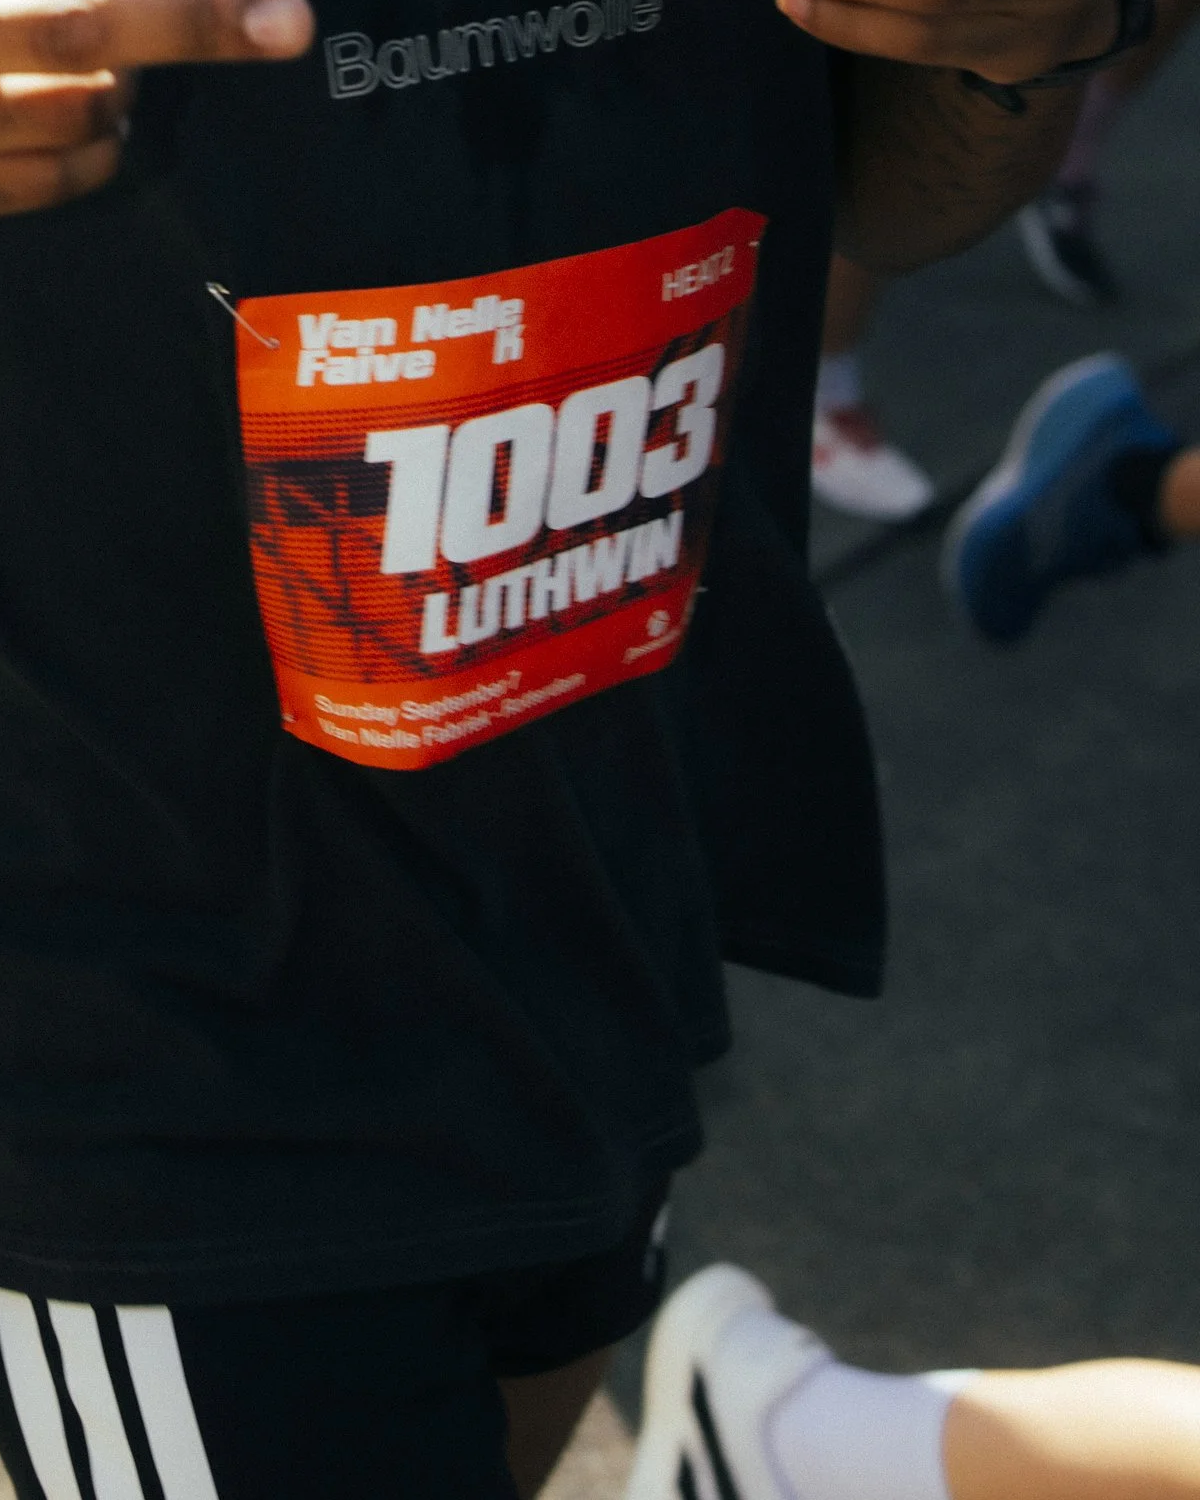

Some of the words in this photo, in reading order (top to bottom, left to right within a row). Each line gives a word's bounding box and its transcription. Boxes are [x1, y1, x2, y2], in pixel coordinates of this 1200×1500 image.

[297, 313, 397, 350] Van
[410, 295, 525, 343] Nelle
[296, 347, 437, 387] Faive
[363, 342, 725, 575] 1003
[419, 510, 684, 654] LUTHWIN
[314, 694, 399, 727] Sunday
